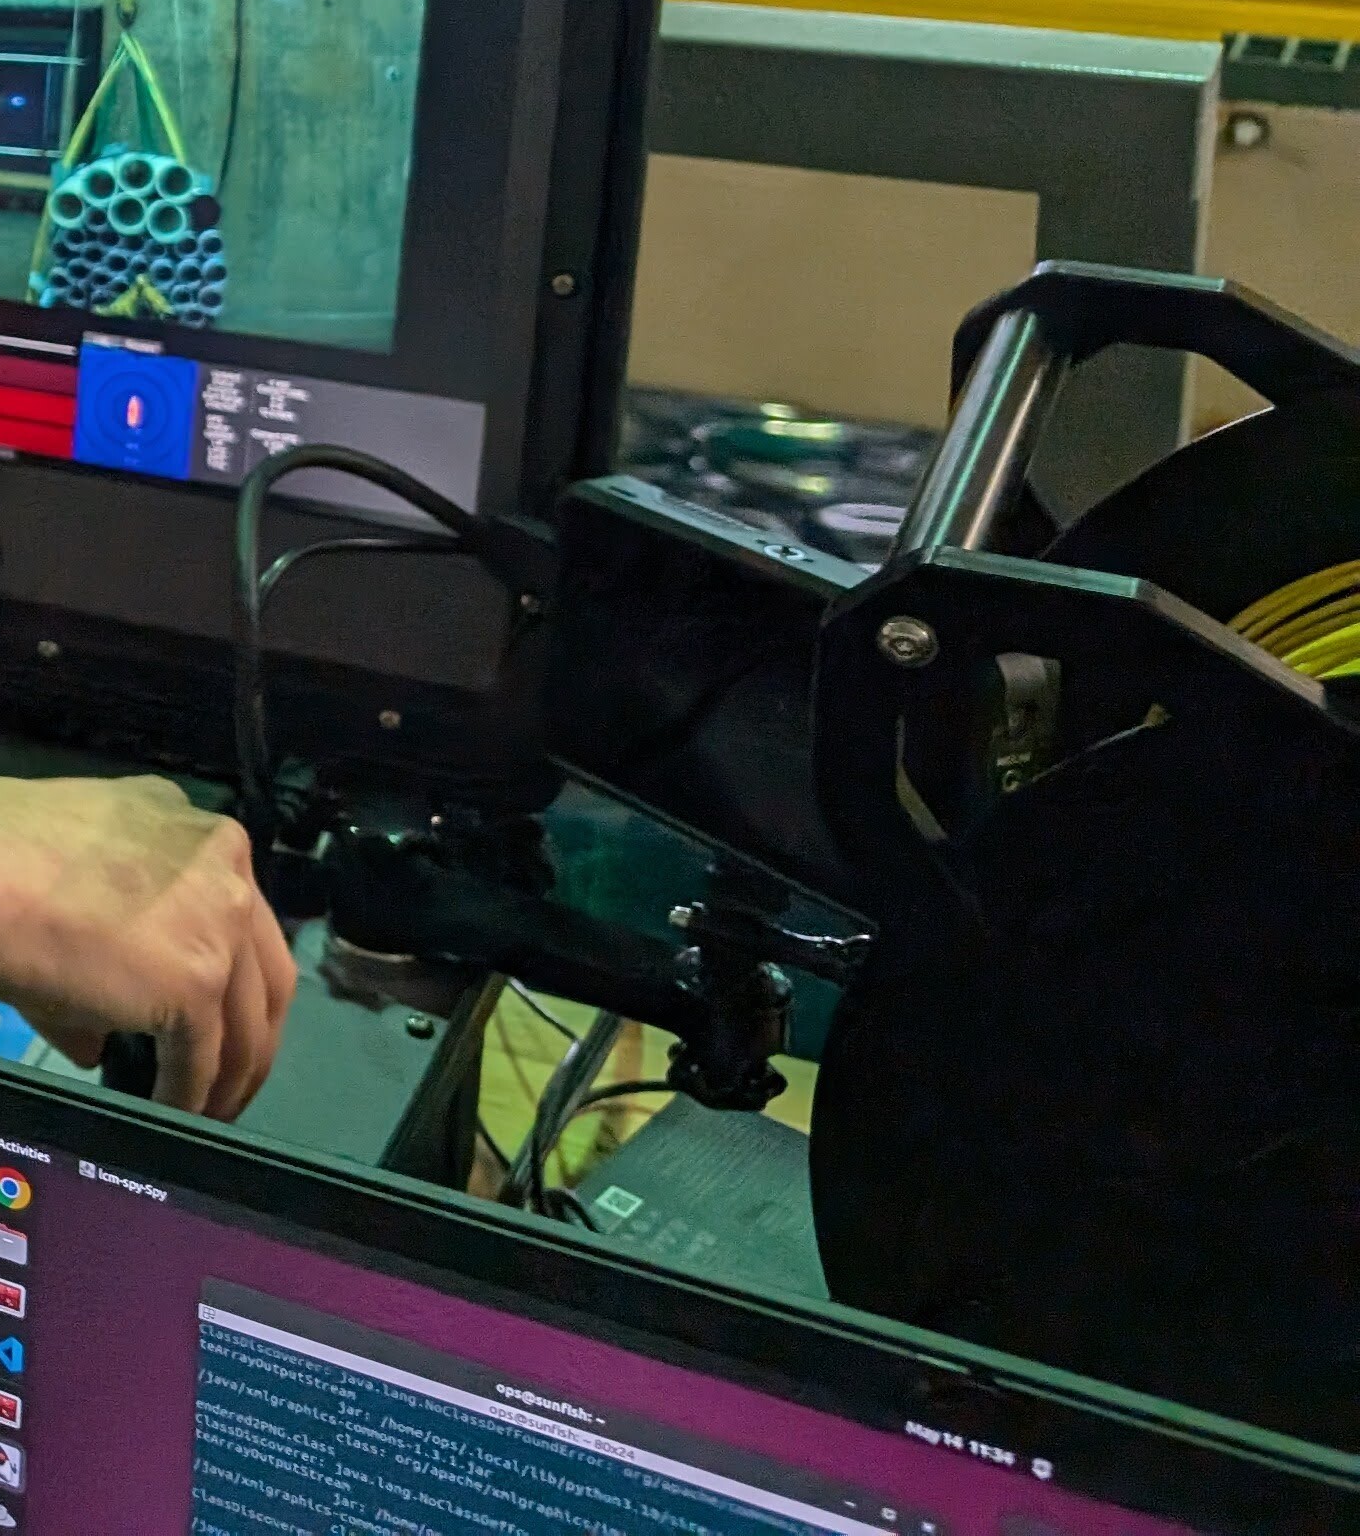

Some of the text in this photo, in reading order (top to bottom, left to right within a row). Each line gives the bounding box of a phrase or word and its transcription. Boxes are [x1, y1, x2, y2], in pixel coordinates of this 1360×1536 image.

[97, 1167, 168, 1202] lcm-spy-Spy
[337, 1401, 372, 1422] jar:
[495, 1380, 593, 1425] ops@sunfish:
[194, 1413, 326, 1468] ClassDiscoverer:
[335, 1431, 388, 1458] class:
[488, 1403, 580, 1443] ops@sunfish:
[594, 1439, 636, 1462] 80x24
[332, 1491, 366, 1514] jar:
